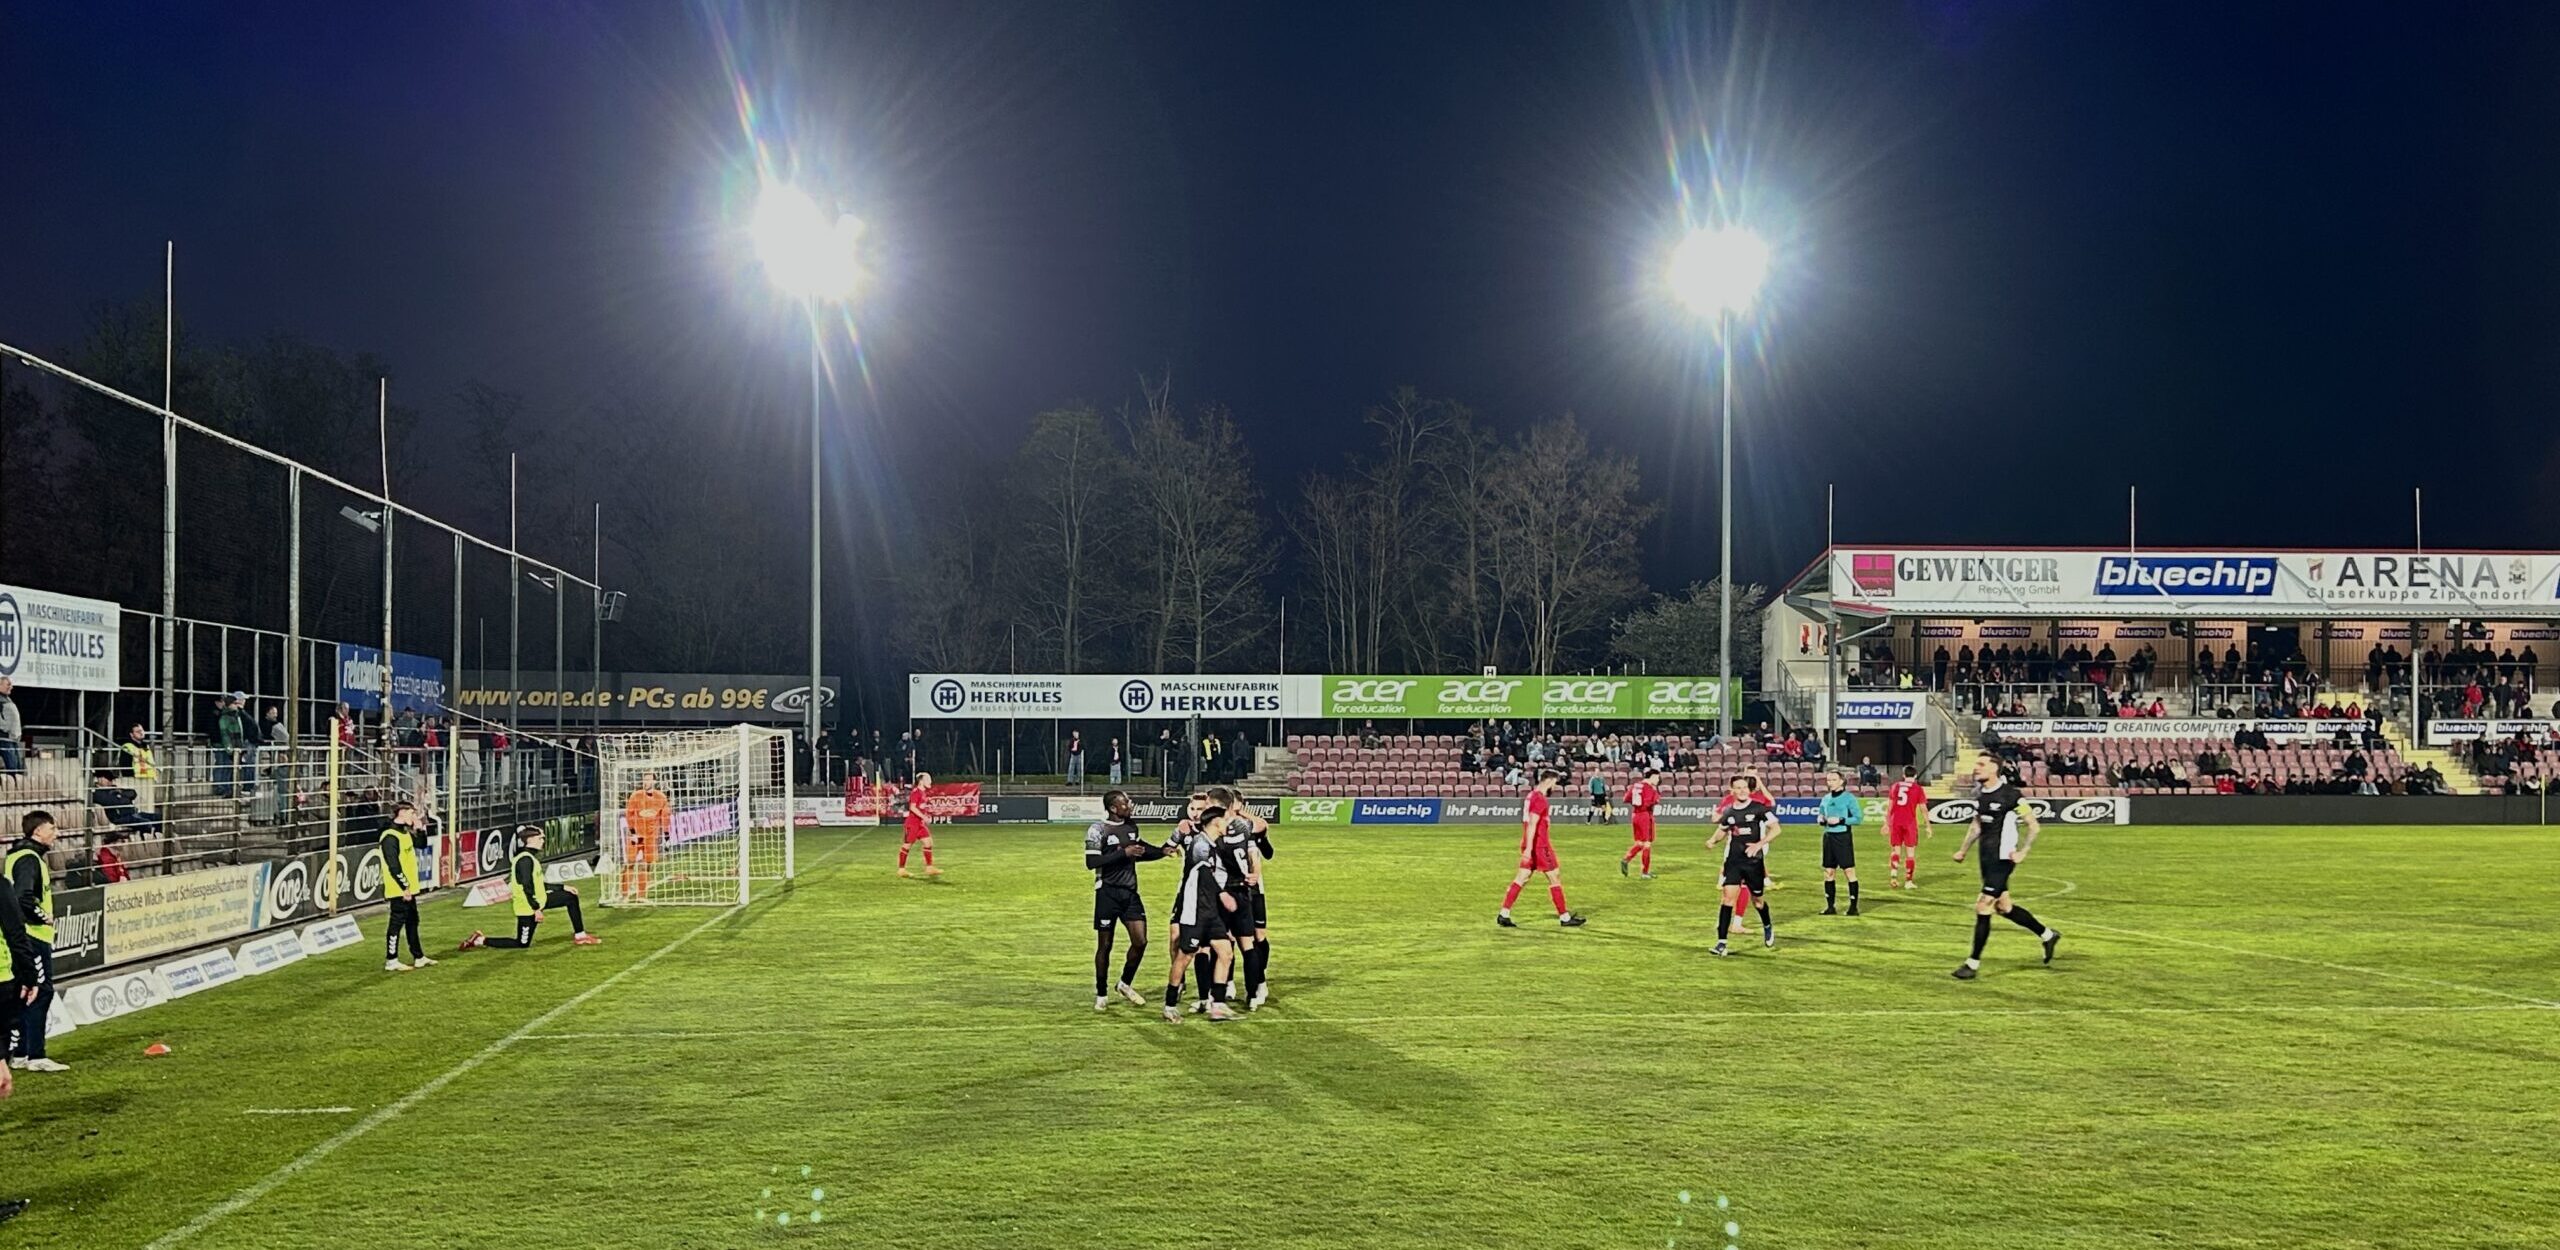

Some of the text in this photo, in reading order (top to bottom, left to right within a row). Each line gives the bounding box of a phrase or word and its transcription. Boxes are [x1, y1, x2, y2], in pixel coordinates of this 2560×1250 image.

[1898, 557, 2060, 583] GEWENIGER
[2101, 560, 2271, 593] bluechip
[2336, 556, 2500, 588] ARENA
[2028, 584, 2060, 594] GmbH
[27, 603, 104, 625] MASCHINENFABRIK
[1921, 626, 1963, 637] luechip
[1981, 626, 2031, 637] bluechip
[2116, 627, 2166, 638] bluechip
[27, 626, 104, 659] HERKULES
[1486, 668, 1494, 677] H
[912, 676, 920, 685] G
[970, 681, 1062, 689] MASCHINENFABRIK
[1161, 682, 1280, 691] MASCHINENFABRIK
[970, 691, 1062, 704] HERKULES
[1332, 680, 1418, 702] acer
[1437, 680, 1524, 702] acer
[1543, 681, 1628, 703] acer
[459, 687, 768, 710] www.one.de PCs ab 99€
[1161, 695, 1280, 711] HERKULES
[2053, 721, 2106, 732] bluechip
[2114, 722, 2237, 733] CREATING COMPUTER
[2435, 723, 2486, 733] bluechip
[1897, 785, 1908, 806] 5
[1290, 800, 1344, 815] acer
[1361, 804, 1432, 817] bluechip
[1446, 804, 1466, 816] Ihr
[1469, 804, 1521, 816] Partner
